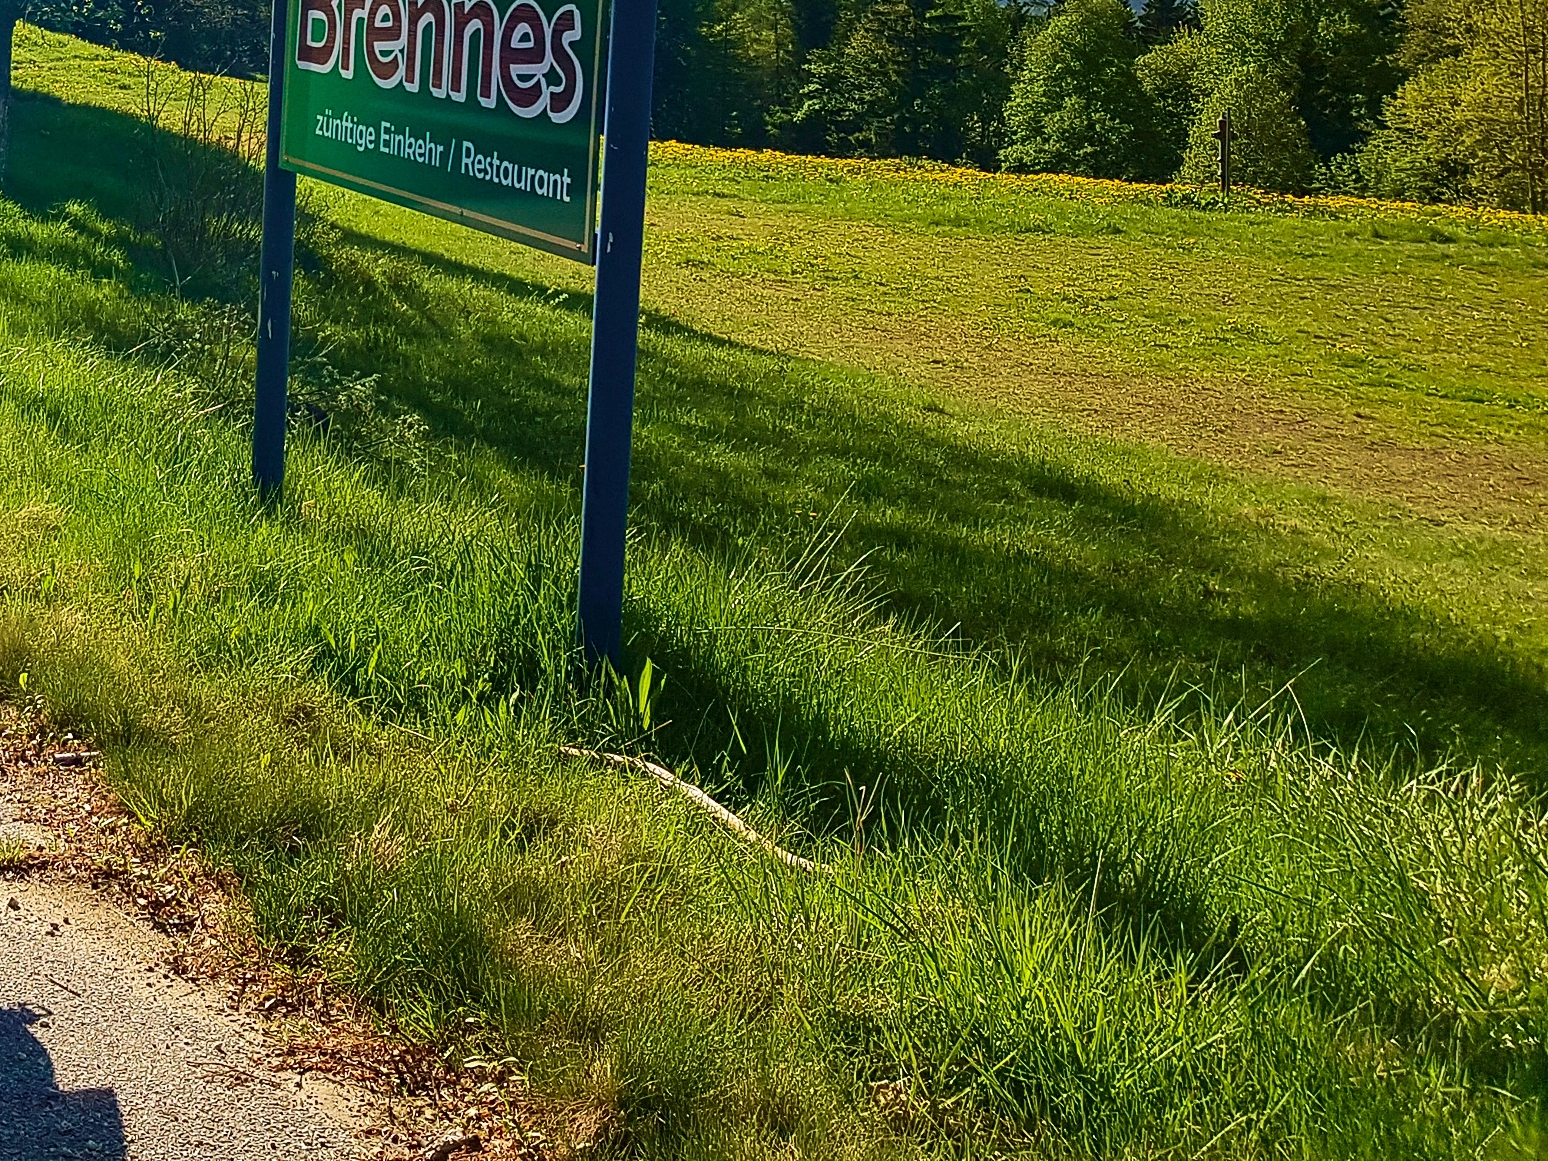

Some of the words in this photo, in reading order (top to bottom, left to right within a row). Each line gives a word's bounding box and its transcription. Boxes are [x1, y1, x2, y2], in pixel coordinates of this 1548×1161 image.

[315, 109, 375, 151] zünftige
[379, 121, 444, 167] Einkehr
[461, 141, 571, 202] Restaurant
